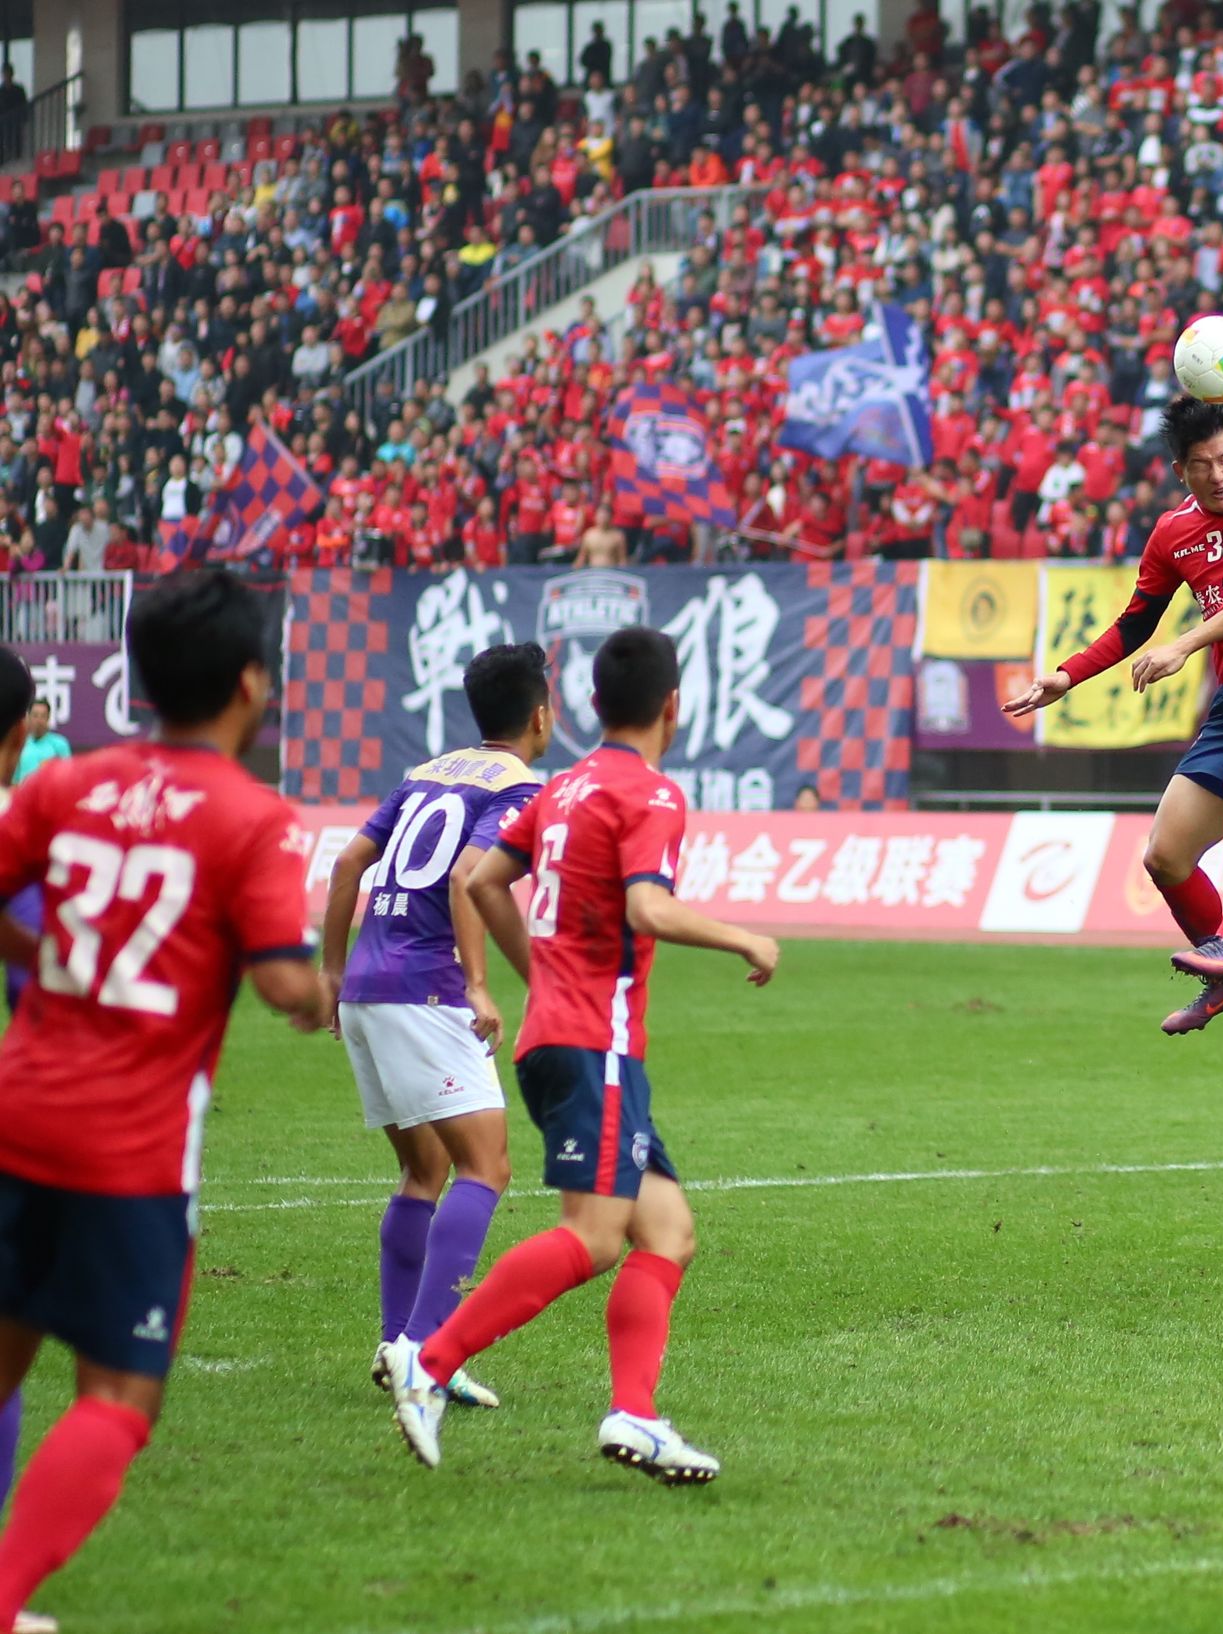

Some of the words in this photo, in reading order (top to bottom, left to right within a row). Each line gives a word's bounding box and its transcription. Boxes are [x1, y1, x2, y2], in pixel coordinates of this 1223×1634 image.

[1174, 544, 1206, 559] KELME
[373, 792, 466, 890] 10
[373, 892, 410, 917] 杨晨
[38, 831, 195, 1016] 32
[437, 1085, 465, 1097] KELME
